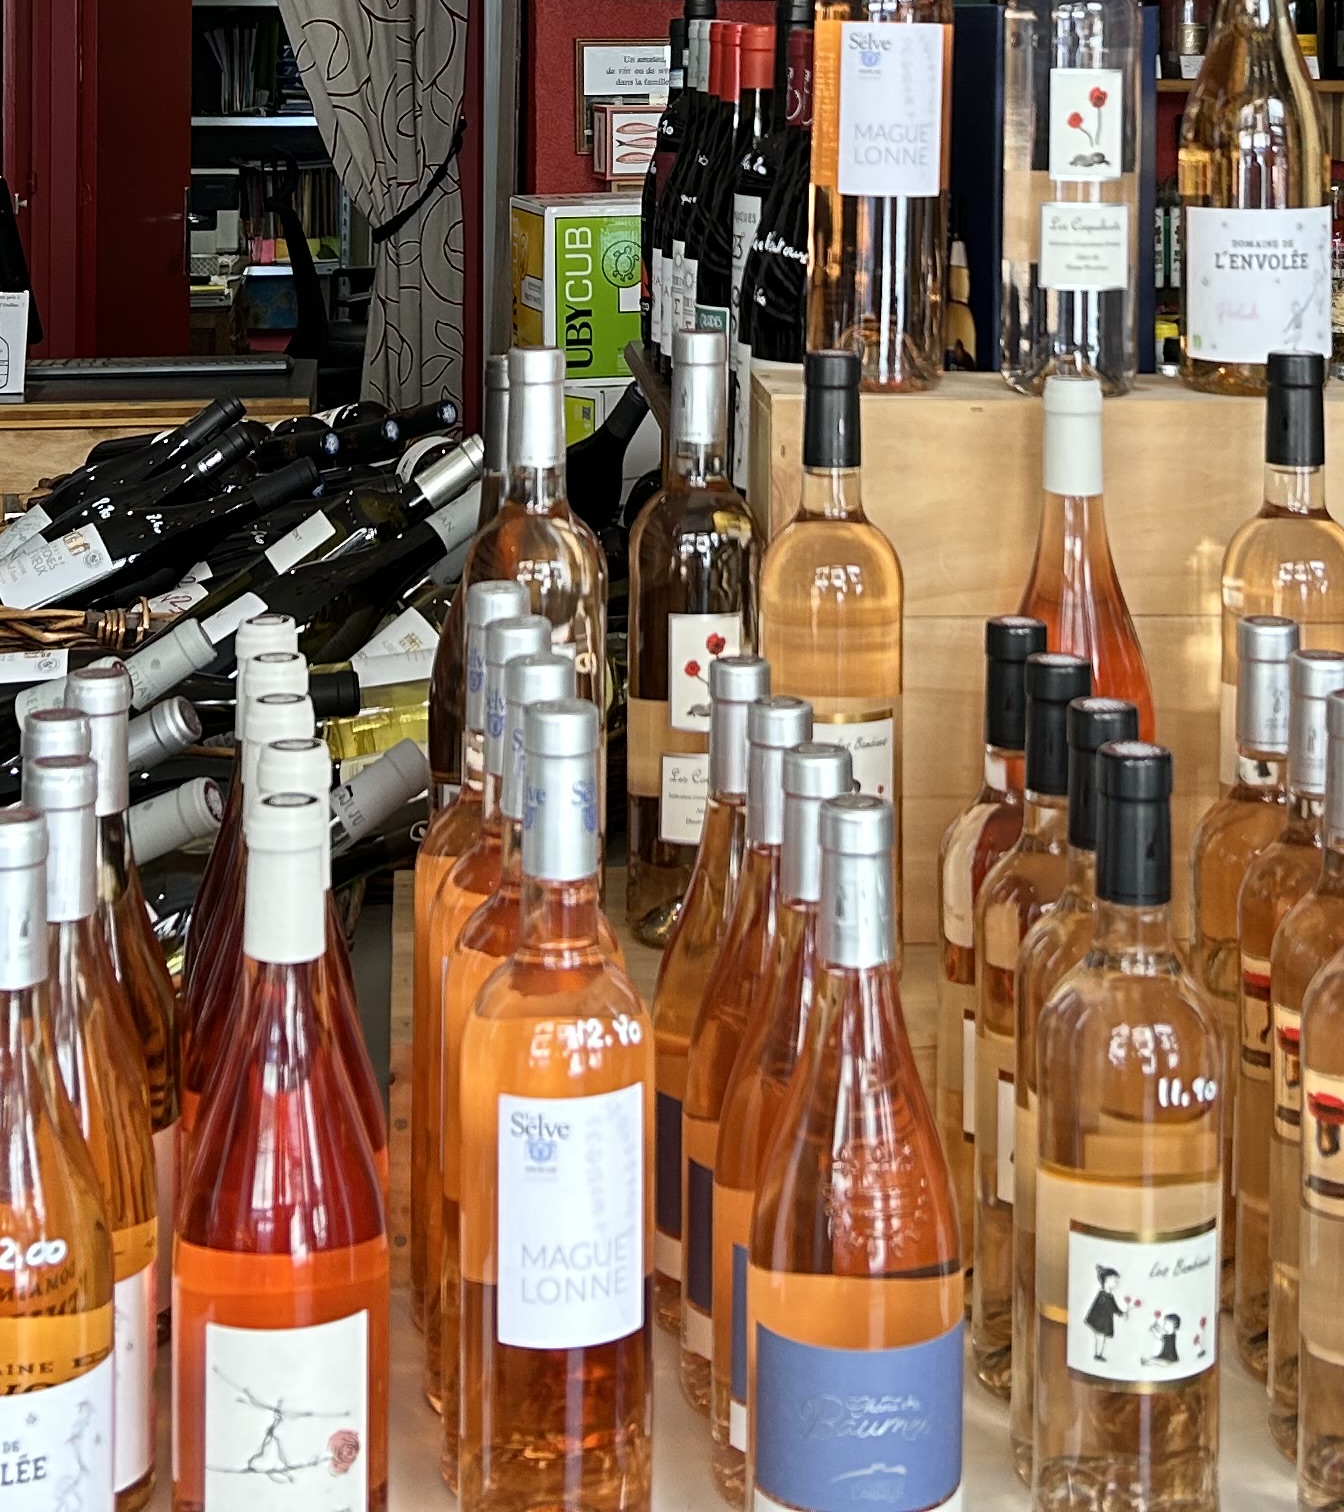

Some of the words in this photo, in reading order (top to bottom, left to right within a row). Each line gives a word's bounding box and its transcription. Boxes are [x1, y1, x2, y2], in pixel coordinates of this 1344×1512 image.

[853, 124, 930, 143] MAGUE
[853, 145, 929, 166] LONNE
[1215, 251, 1309, 272] L'ENVOLÉE
[521, 1234, 627, 1272] MAGUE
[521, 1269, 627, 1305] LONNE
[2, 1440, 20, 1453] DE
